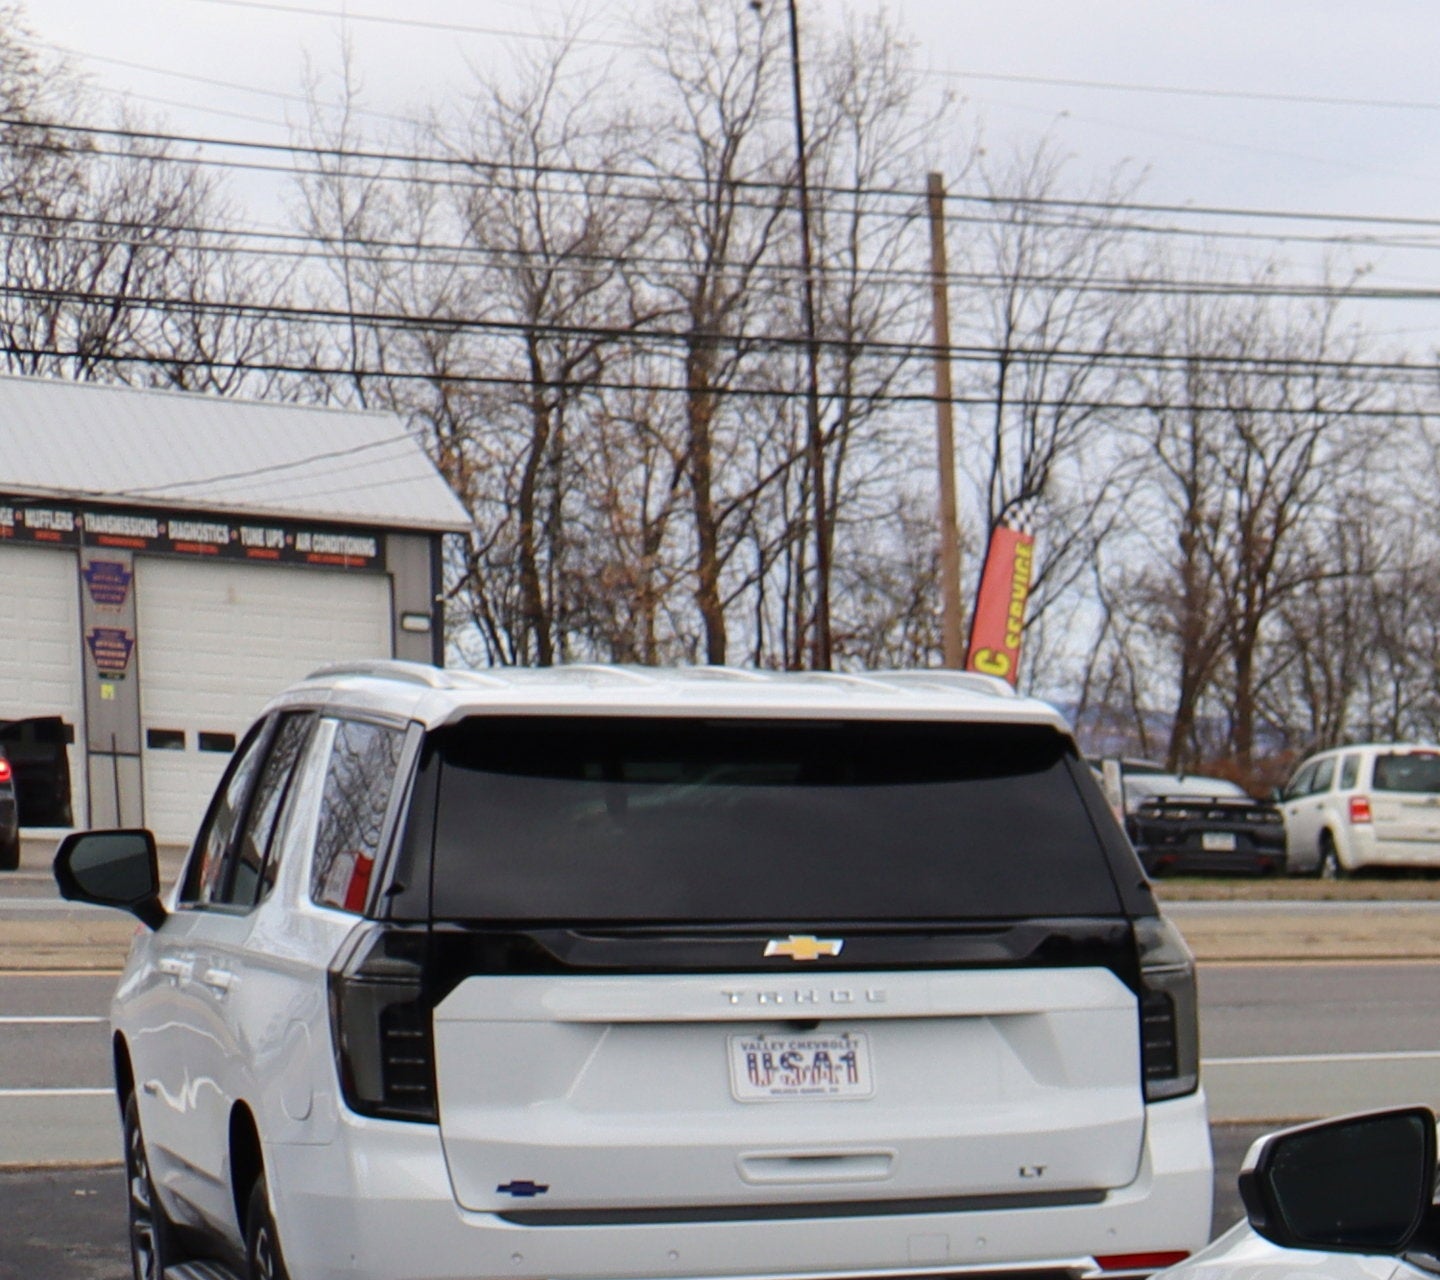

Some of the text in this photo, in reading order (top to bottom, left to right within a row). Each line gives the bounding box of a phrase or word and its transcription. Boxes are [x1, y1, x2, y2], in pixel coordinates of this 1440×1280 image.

[24, 508, 75, 532] MUFFLERS
[84, 513, 159, 539] TRANSMISSIONS
[168, 520, 230, 545] DIAGNOSTICS
[312, 534, 376, 558] CONDITIONING
[721, 989, 887, 1005] TAHOE
[741, 1039, 860, 1051] VALLEY CHEVROLET
[1018, 1165, 1048, 1178] LT
